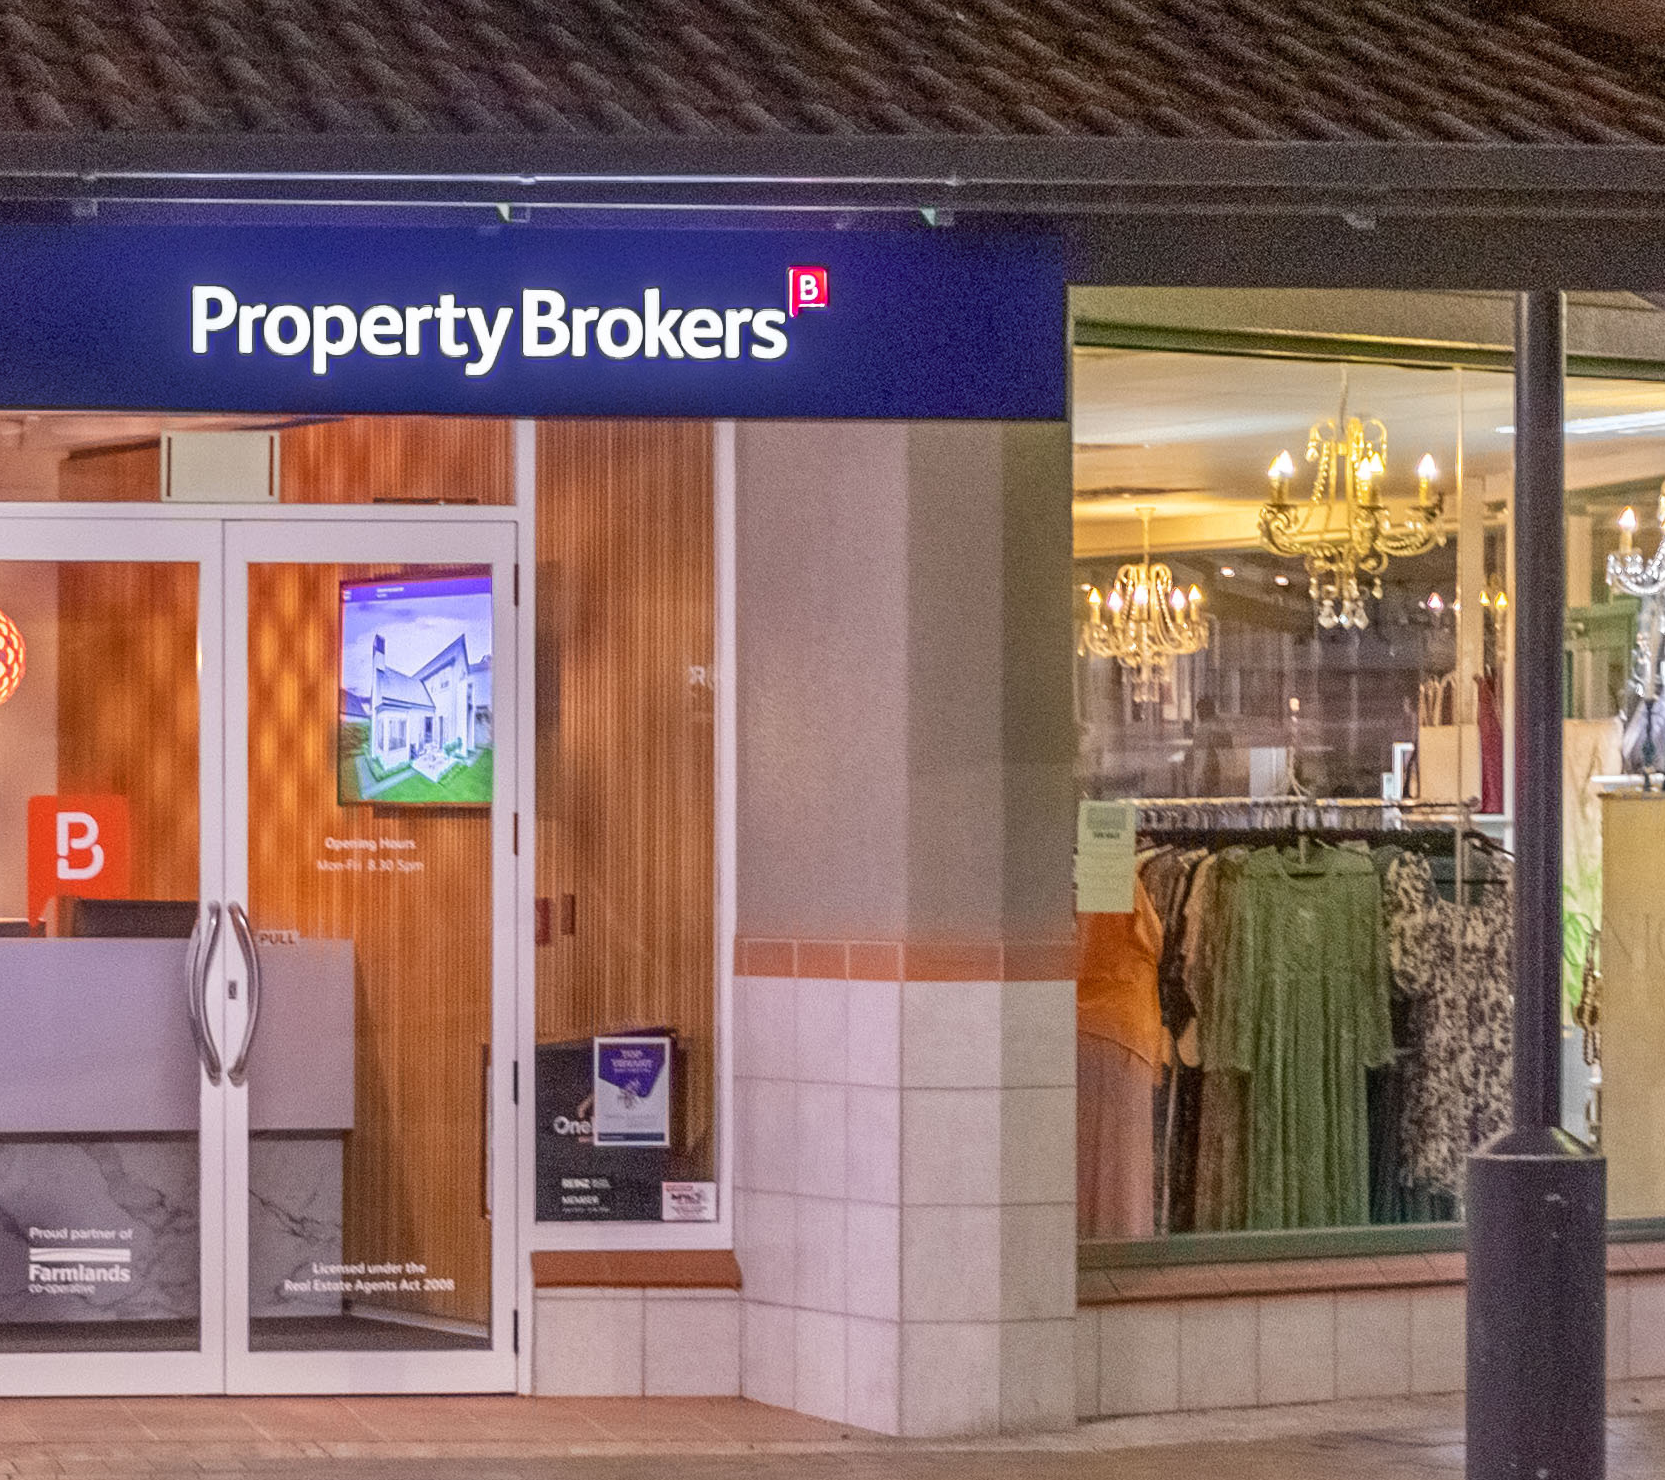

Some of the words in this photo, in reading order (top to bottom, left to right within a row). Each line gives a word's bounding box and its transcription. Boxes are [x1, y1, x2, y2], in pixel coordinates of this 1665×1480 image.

[800, 274, 819, 301] B
[57, 811, 105, 880] B
[324, 836, 377, 852] Opening
[379, 837, 417, 850] Hours
[260, 933, 294, 945] PULL
[553, 1115, 593, 1135] One
[29, 1226, 68, 1239] Proud
[70, 1228, 117, 1241] partner
[119, 1228, 133, 1239] of
[29, 1263, 131, 1282] Farmlands
[312, 1262, 366, 1275] Licensed
[368, 1262, 403, 1274] under
[404, 1261, 427, 1274] the
[284, 1279, 311, 1292] Real
[312, 1279, 353, 1292] Estate
[354, 1279, 398, 1295] Agents
[399, 1278, 421, 1291] Act
[423, 1277, 456, 1292] 2008
